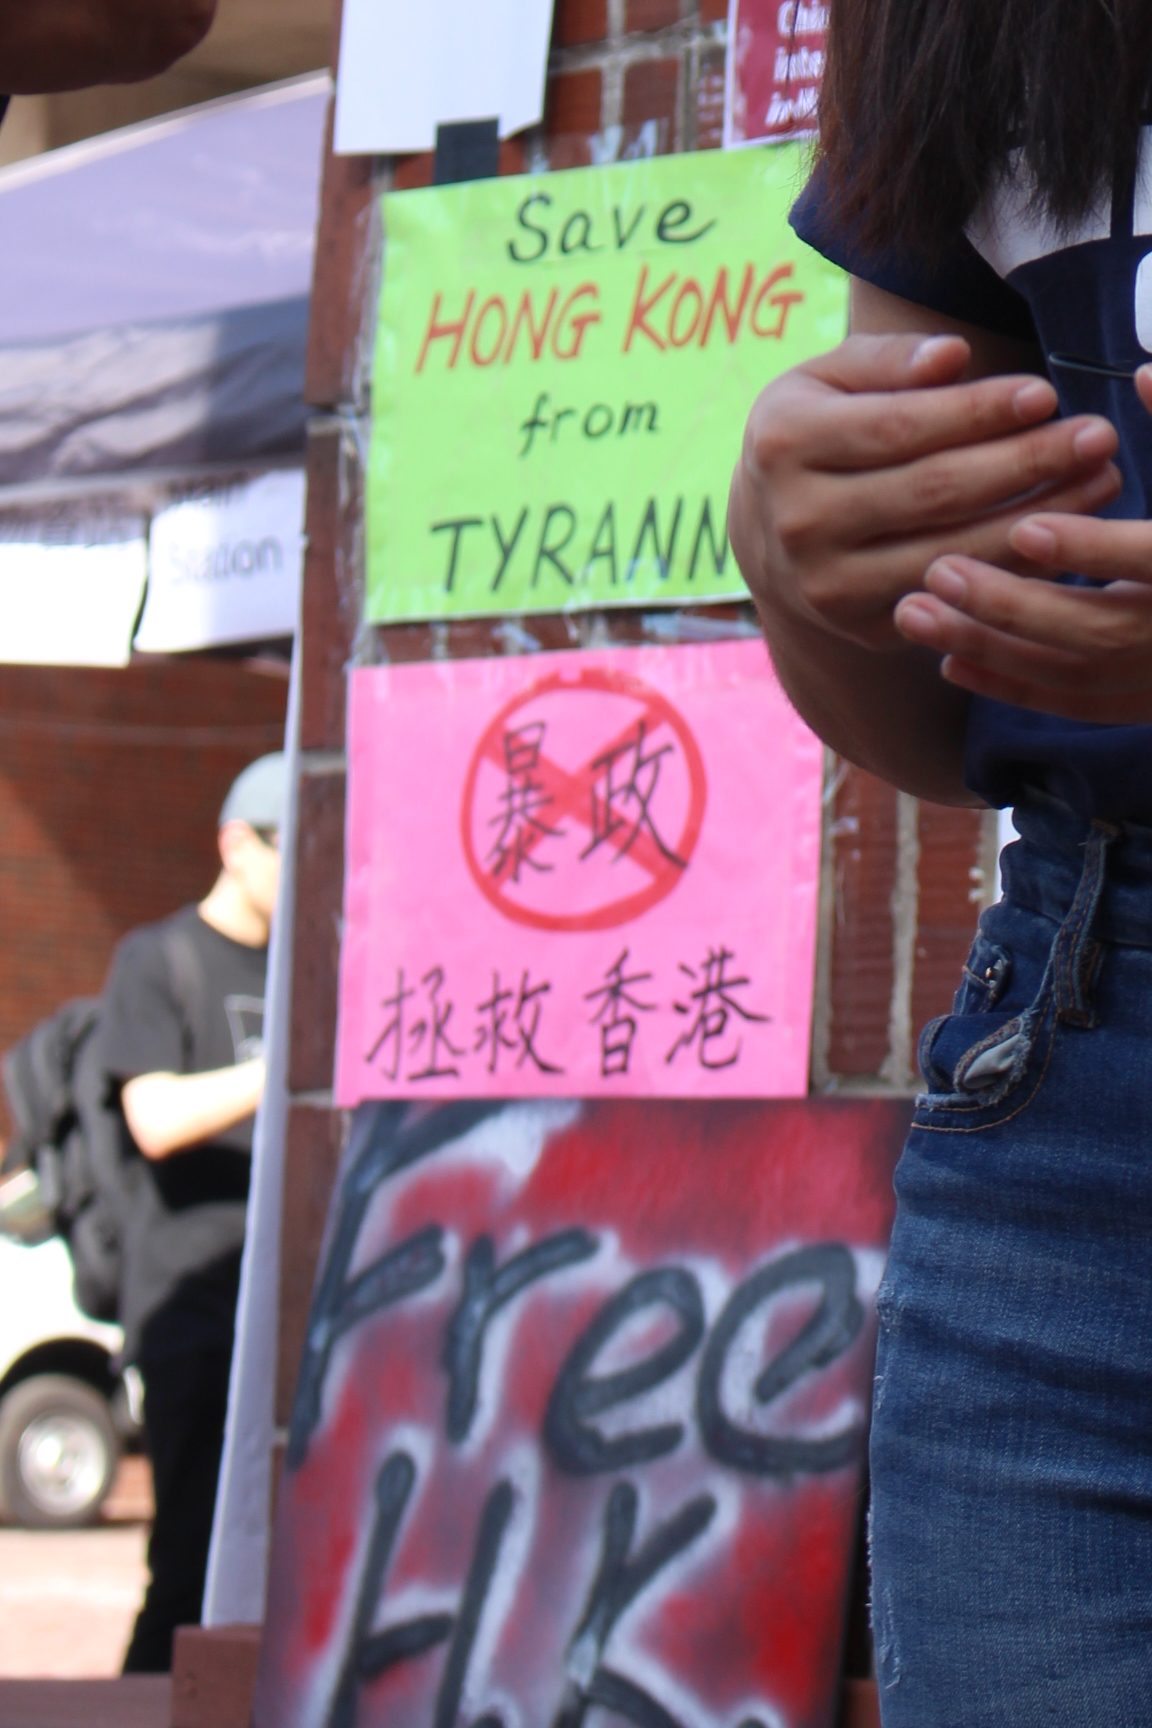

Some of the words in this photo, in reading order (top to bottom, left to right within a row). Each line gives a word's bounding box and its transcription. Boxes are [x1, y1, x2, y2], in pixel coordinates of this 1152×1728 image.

[507, 192, 718, 264] Save
[415, 282, 601, 374] HONG
[622, 262, 805, 355] KONG
[519, 392, 660, 459] from
[430, 494, 738, 594] TYRANN
[365, 945, 774, 1084] 拯救香港
[287, 1100, 866, 1476] Free
